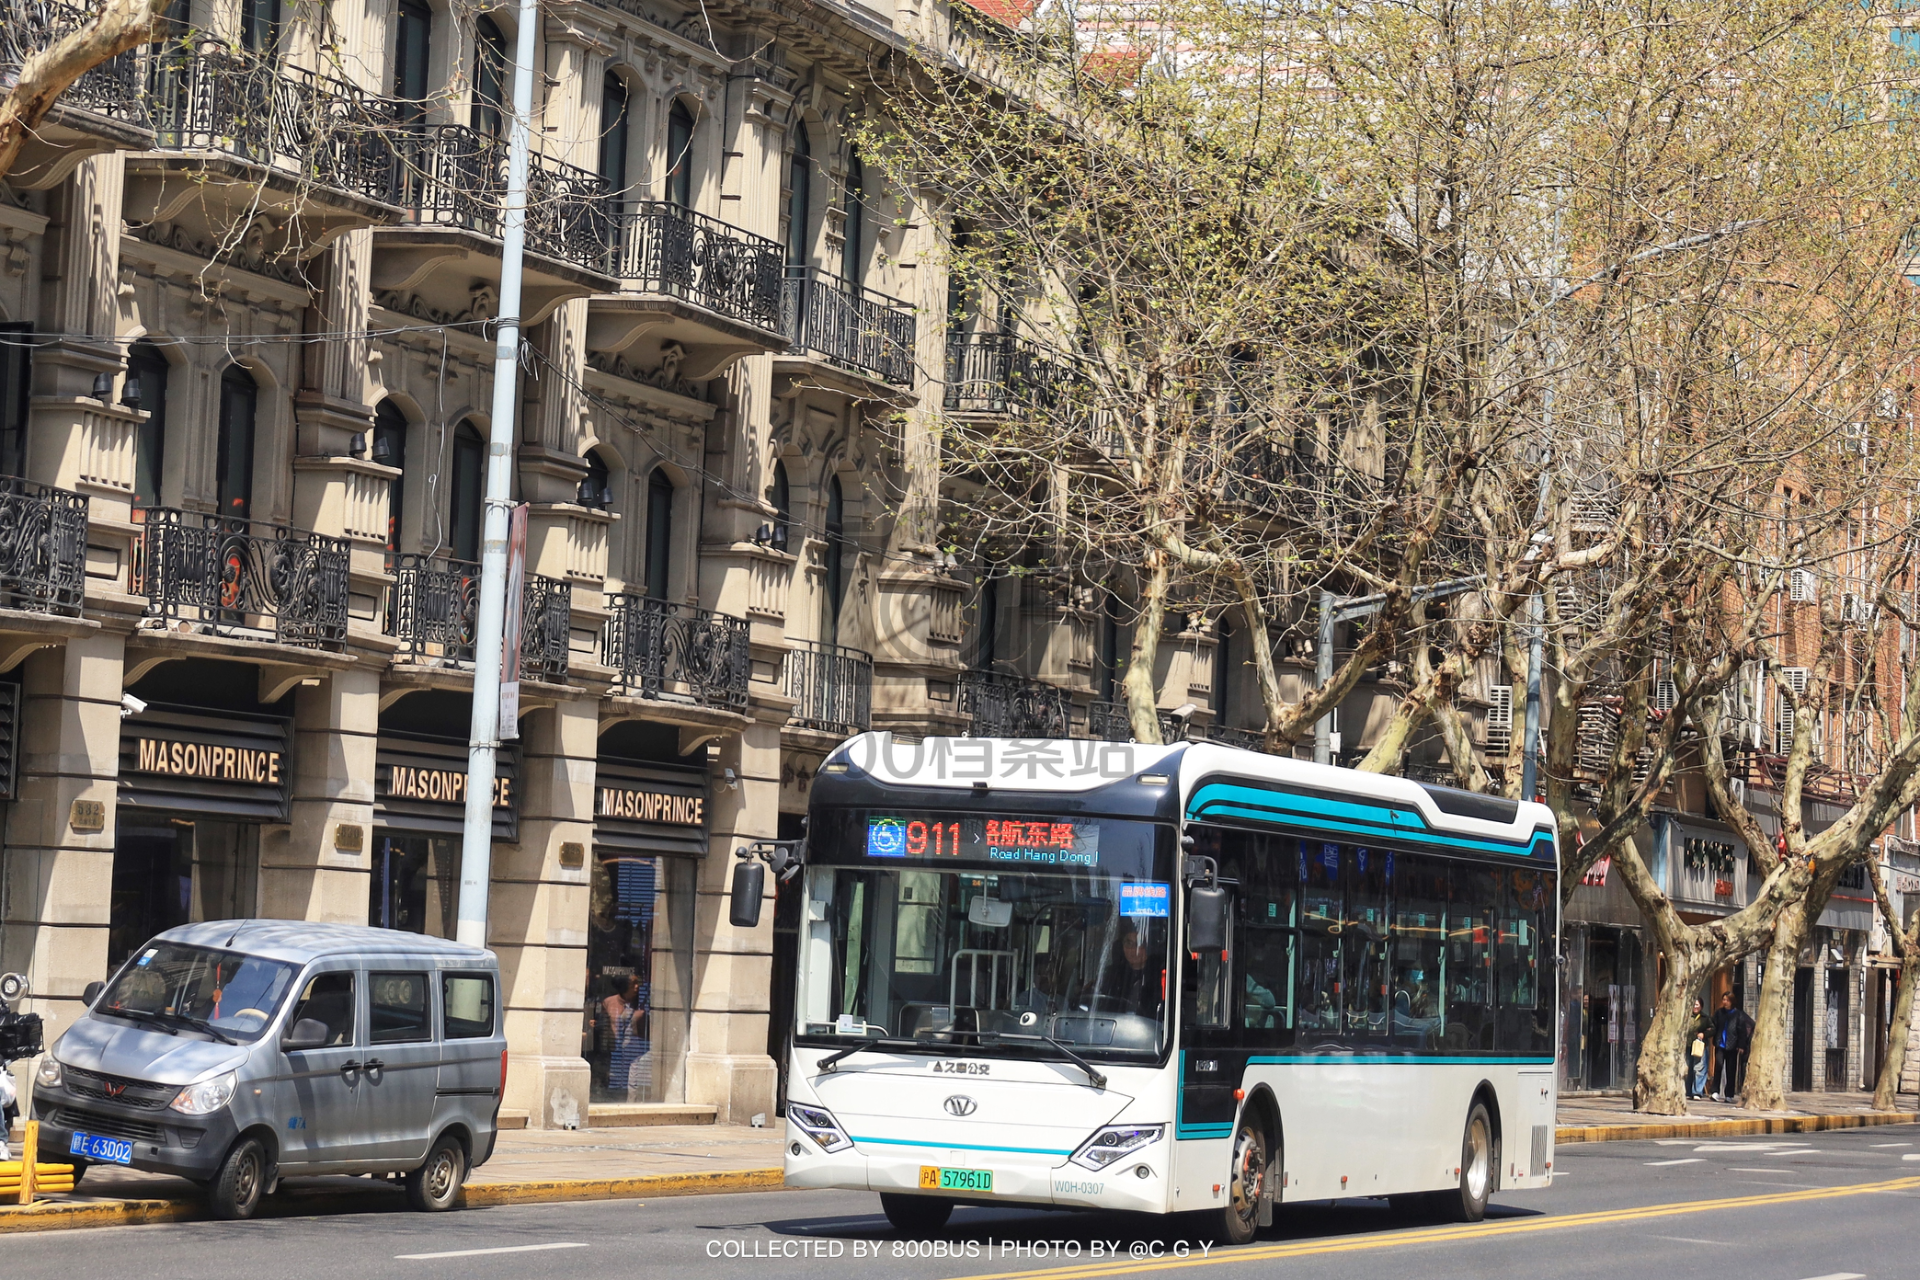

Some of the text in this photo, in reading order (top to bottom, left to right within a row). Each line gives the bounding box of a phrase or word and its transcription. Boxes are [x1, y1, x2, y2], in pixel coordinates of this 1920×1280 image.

[139, 738, 280, 783] MASONPRINCE
[391, 766, 511, 807] MASONPCE
[602, 788, 704, 824] MASONPRINCE
[906, 820, 961, 856] 911
[990, 846, 1020, 861] Road
[1024, 848, 1056, 864] Hang
[1059, 849, 1091, 865] Dong
